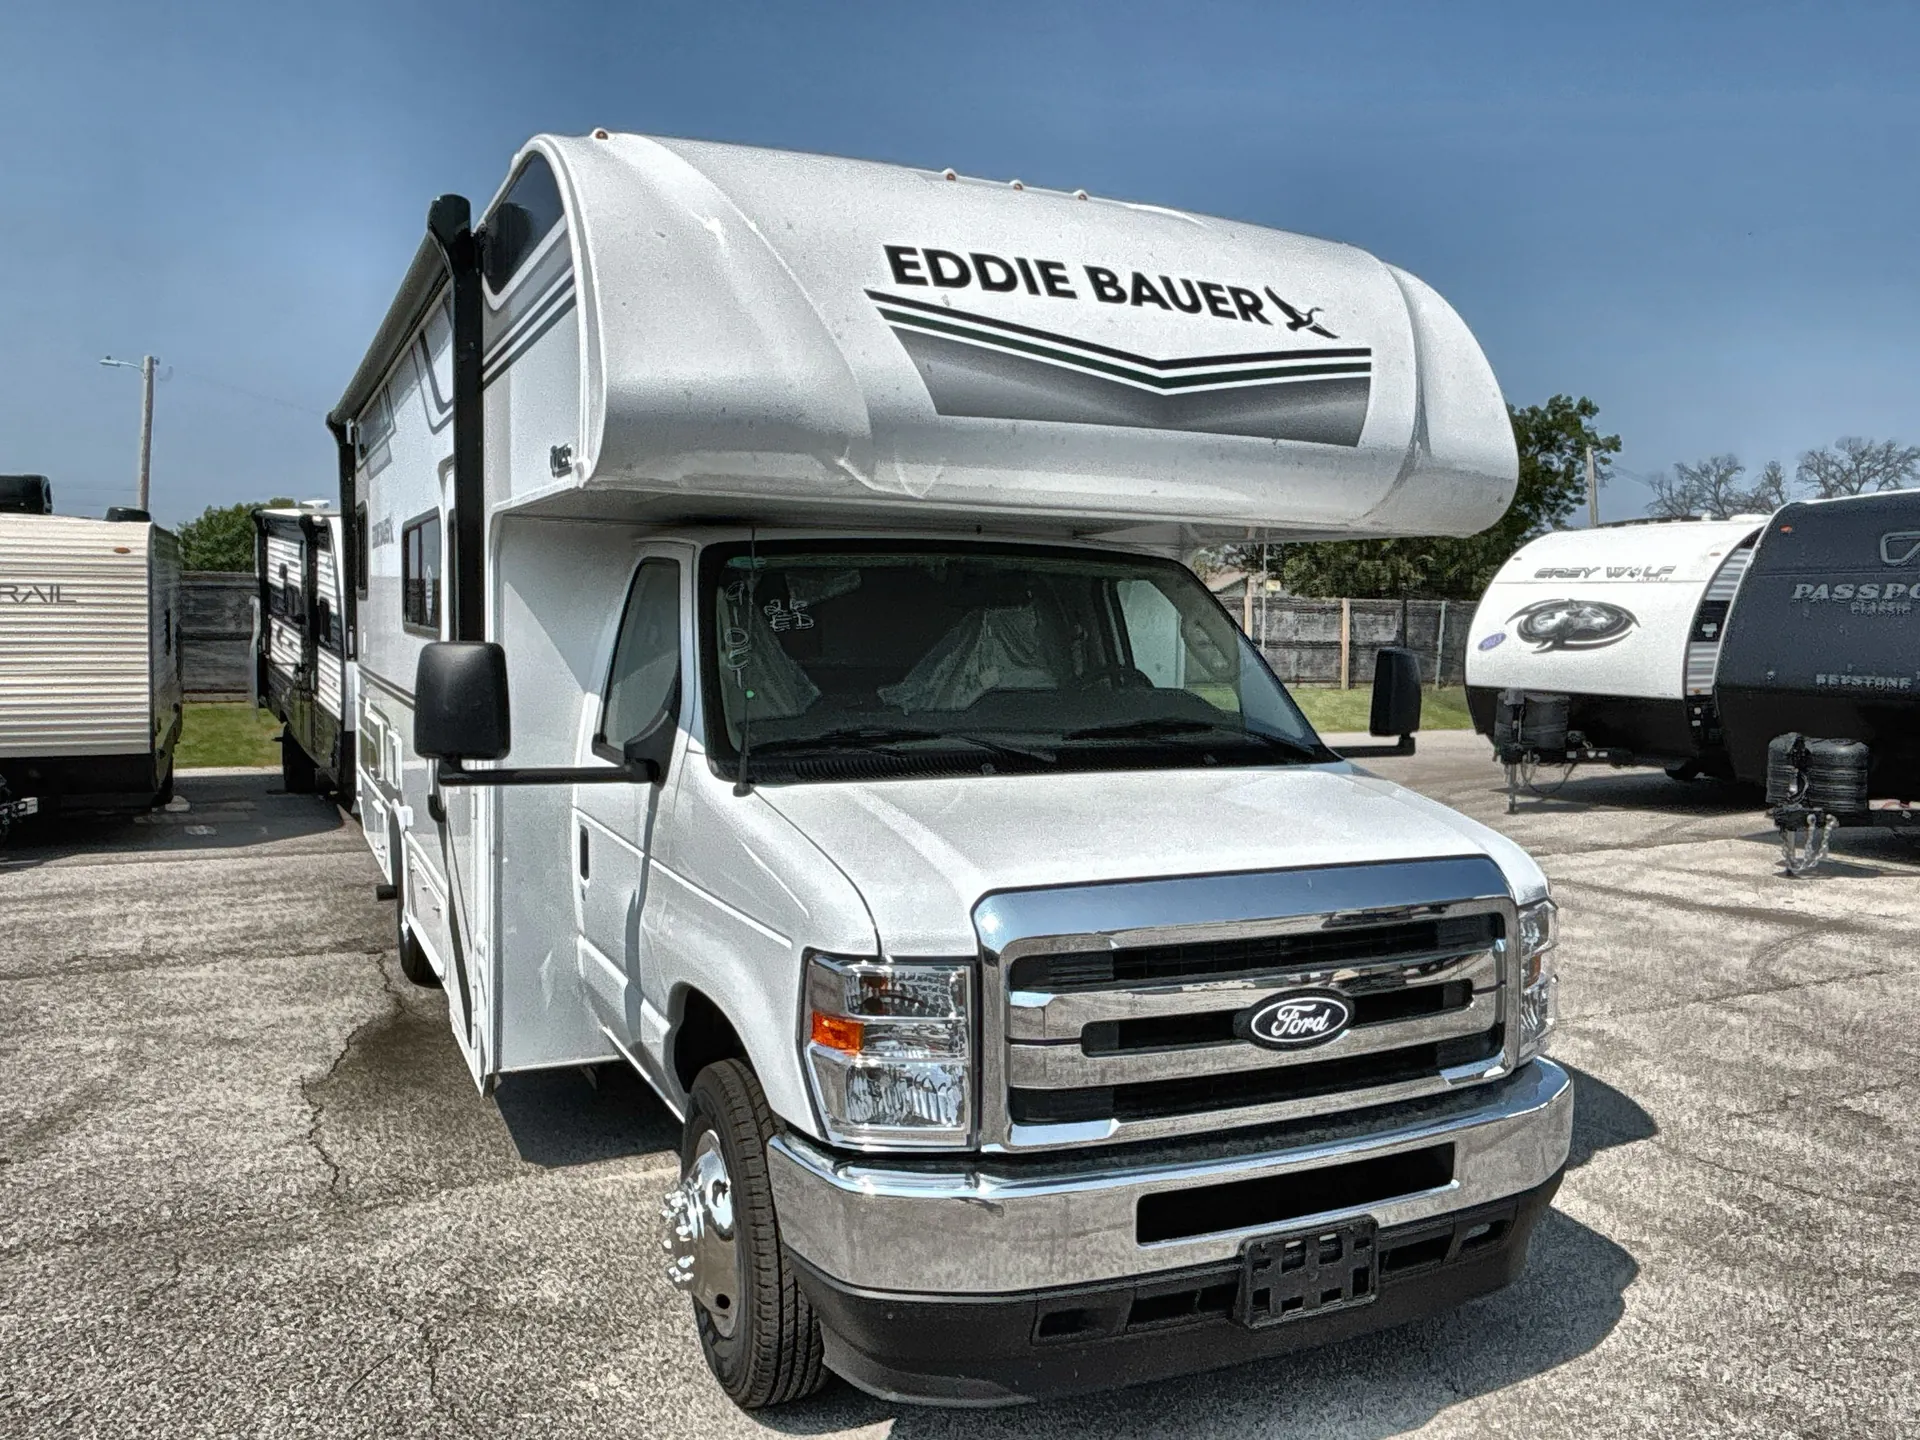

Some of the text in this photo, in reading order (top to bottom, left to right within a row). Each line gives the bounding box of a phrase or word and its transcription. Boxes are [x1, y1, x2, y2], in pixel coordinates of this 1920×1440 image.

[883, 244, 1273, 326] EDDIE BAUER
[1534, 566, 1601, 579] GREY
[1270, 1003, 1331, 1037] Ford
